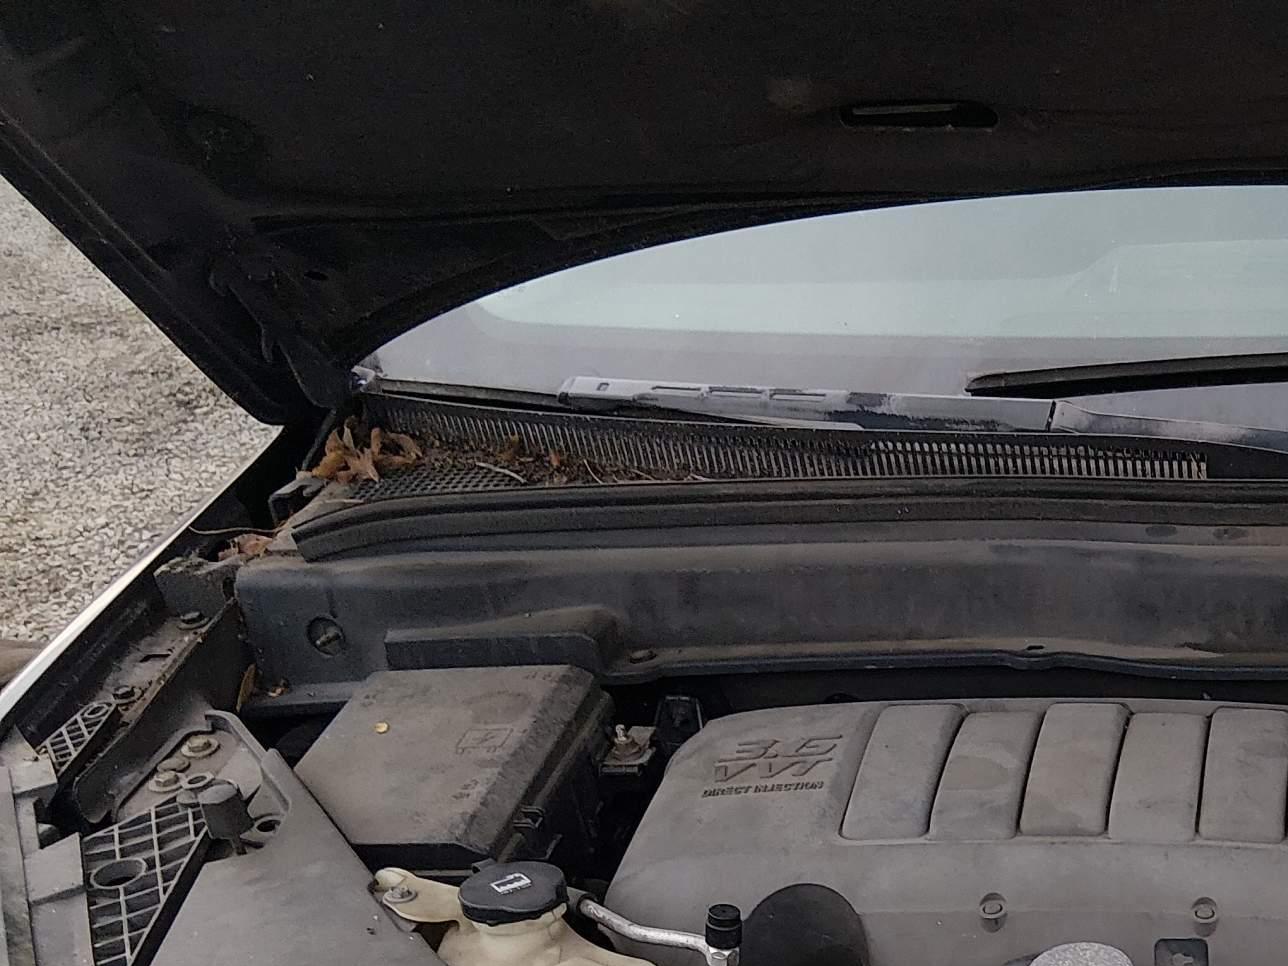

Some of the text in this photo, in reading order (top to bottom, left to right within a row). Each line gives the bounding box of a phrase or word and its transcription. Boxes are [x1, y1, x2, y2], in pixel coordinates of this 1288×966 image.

[714, 757, 833, 783] VVT
[702, 780, 825, 798] DIRECT INJECTION
